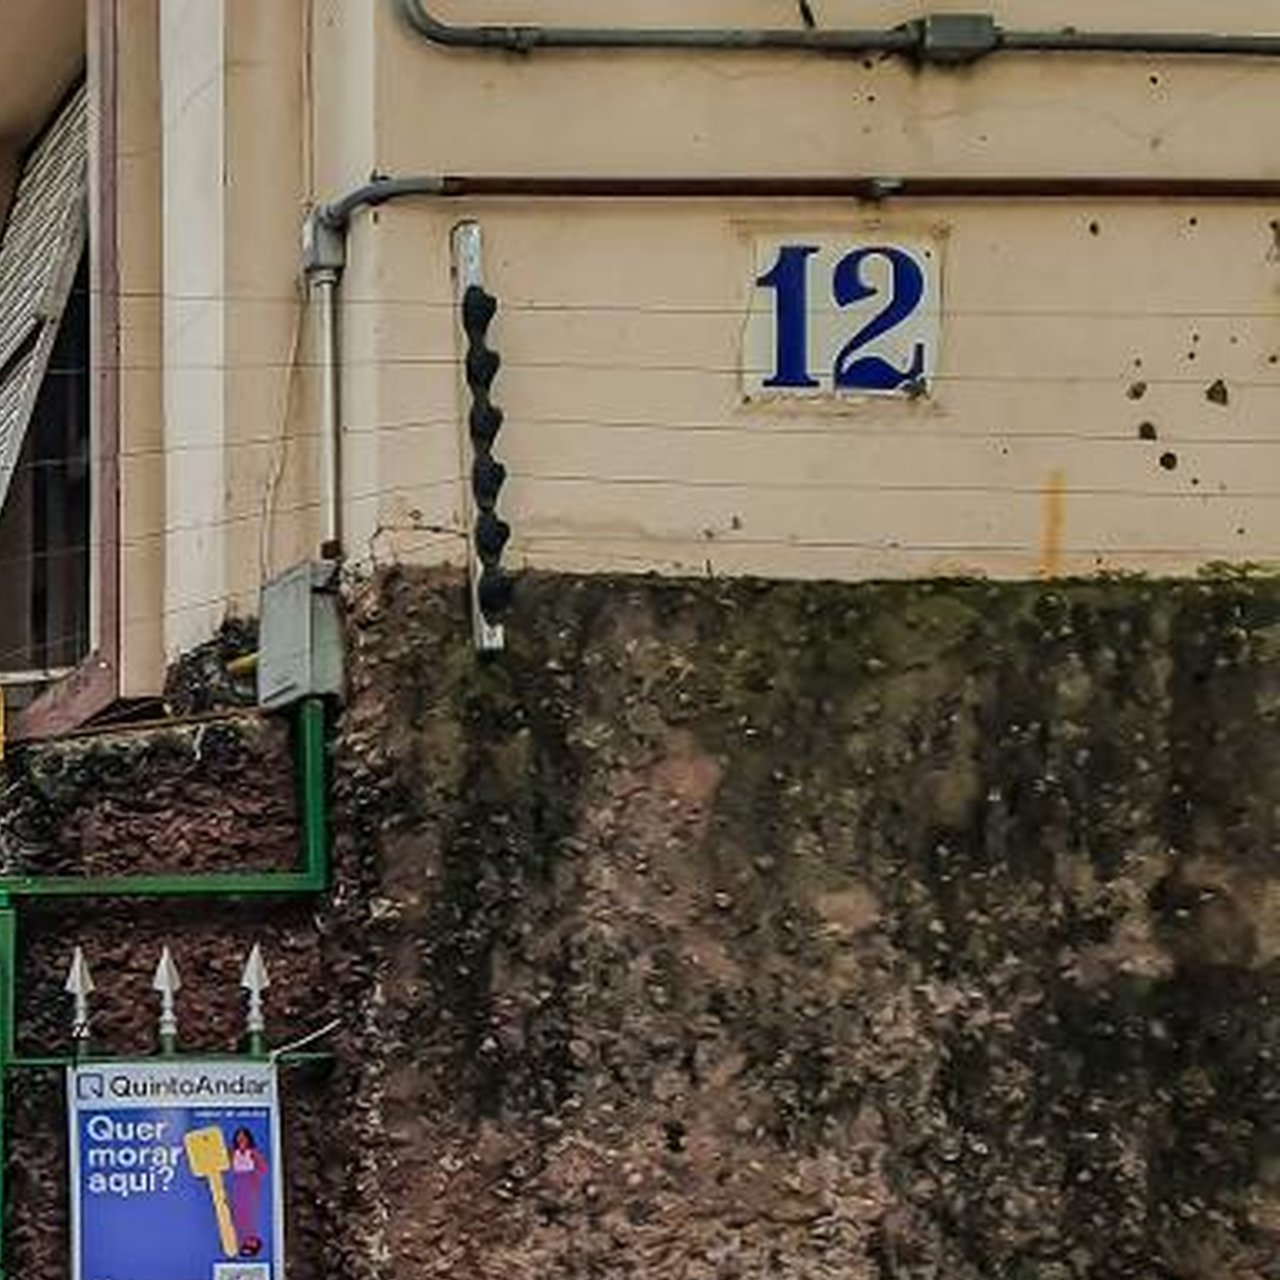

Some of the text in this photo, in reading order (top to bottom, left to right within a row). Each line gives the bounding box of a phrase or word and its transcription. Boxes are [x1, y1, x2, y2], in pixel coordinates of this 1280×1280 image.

[756, 246, 927, 391] 12
[109, 1074, 268, 1098] QuintoAndar
[88, 1115, 167, 1142] Quer
[89, 1146, 182, 1167] morar
[88, 1167, 175, 1197] aqui?
